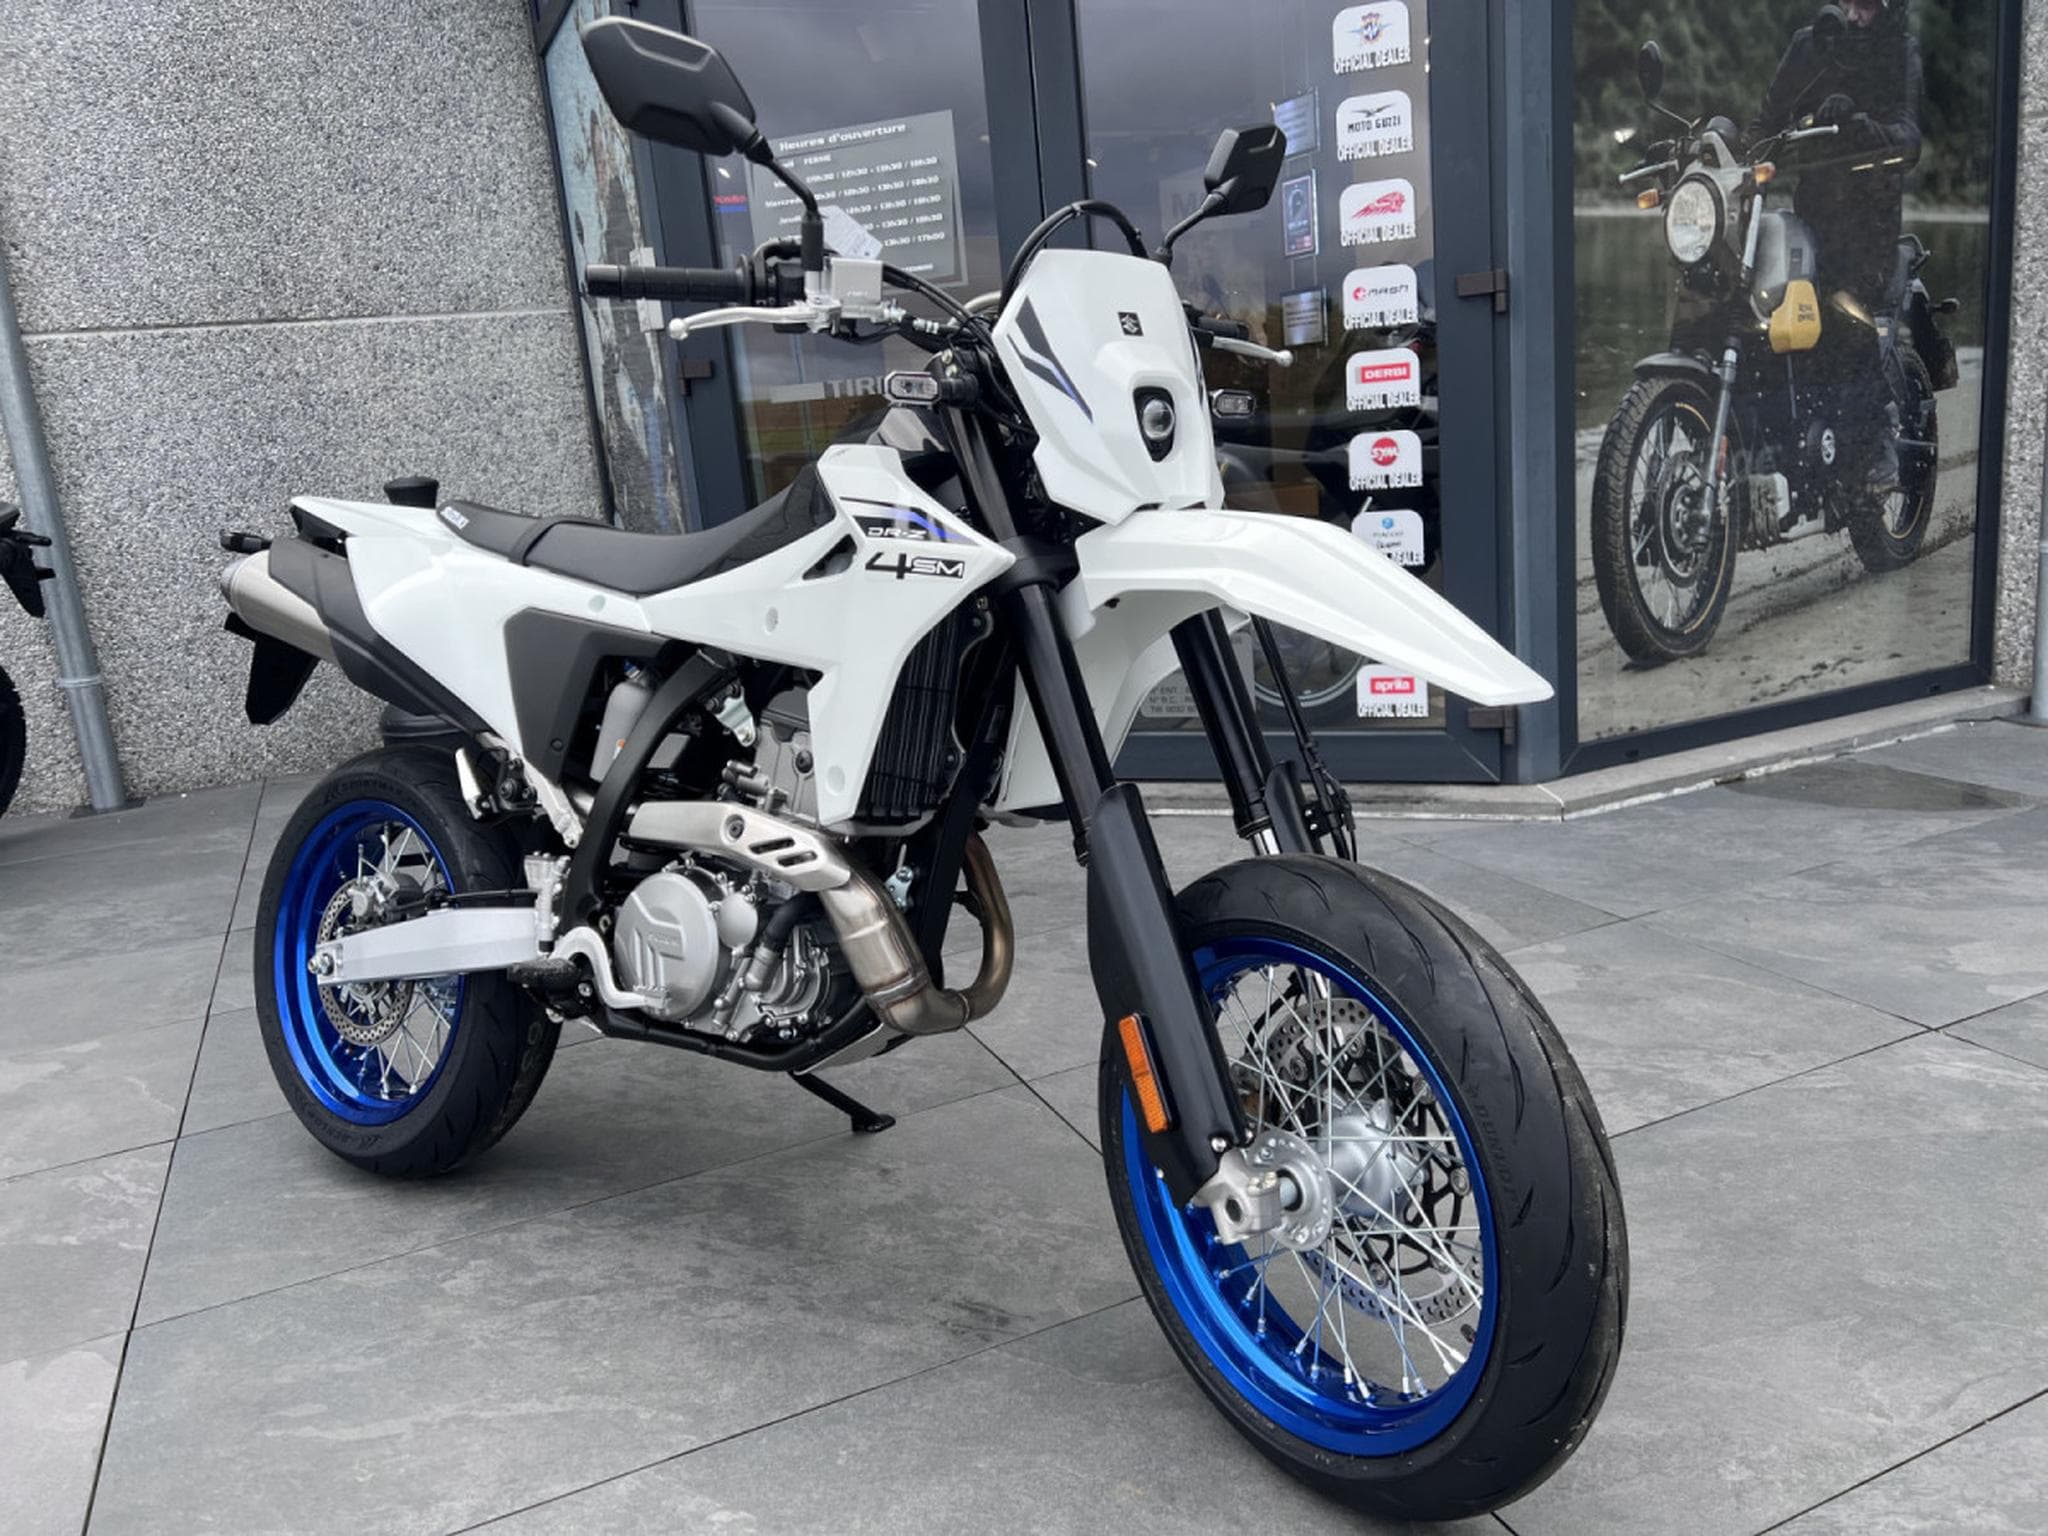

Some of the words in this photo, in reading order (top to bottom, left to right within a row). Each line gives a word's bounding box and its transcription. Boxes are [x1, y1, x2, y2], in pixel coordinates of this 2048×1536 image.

[1334, 52, 1374, 75] OFFICIAL
[1375, 47, 1411, 68] DEALER
[1347, 120, 1372, 133] MOTO
[779, 138, 825, 151] Heures
[828, 124, 906, 144] d'ouverture
[1337, 141, 1377, 162] OFFICIAL
[1378, 136, 1414, 156] DEALER
[1340, 227, 1380, 247] OFFICIAL
[1381, 223, 1416, 242] DEALER
[1343, 311, 1383, 331] OFFICIAL
[1384, 308, 1419, 327] DEALER
[1364, 367, 1407, 380] DERBI
[1346, 393, 1386, 412] OFFICIAL
[1387, 391, 1421, 409] DEALER
[1349, 474, 1388, 492] OFFICIAL
[1389, 472, 1423, 489] DEALER
[867, 526, 928, 540] DR-Z
[1374, 678, 1412, 693] aprilia
[1358, 703, 1396, 718] OFFICIAL
[1396, 703, 1429, 718] DEALER
